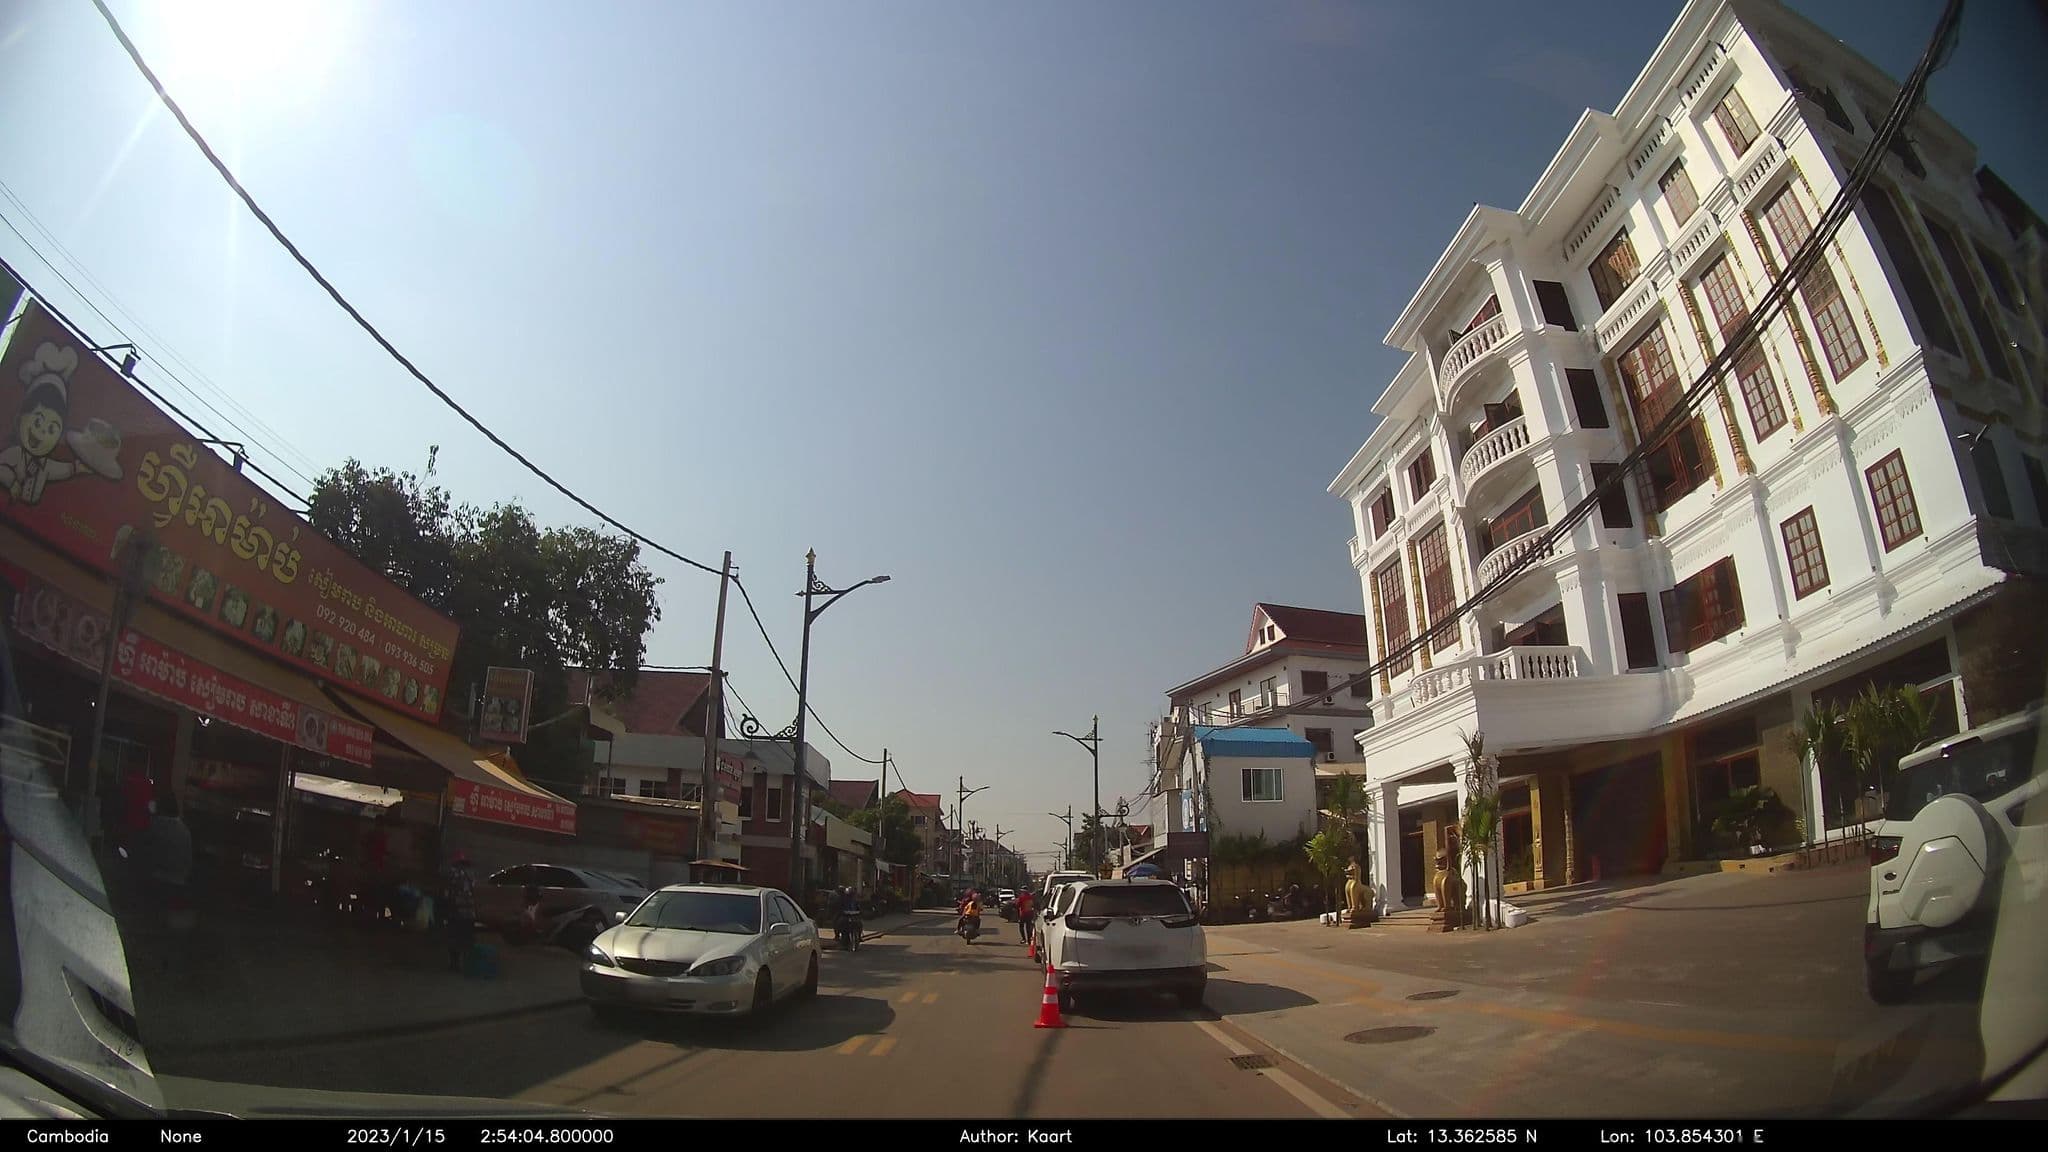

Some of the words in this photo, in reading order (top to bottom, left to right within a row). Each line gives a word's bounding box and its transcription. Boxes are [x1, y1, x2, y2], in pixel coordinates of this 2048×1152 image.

[316, 604, 337, 625] 092
[338, 615, 357, 636] 920
[358, 626, 377, 647] 484
[384, 641, 402, 660] 093
[402, 651, 418, 669] 936
[418, 659, 435, 677] 505
